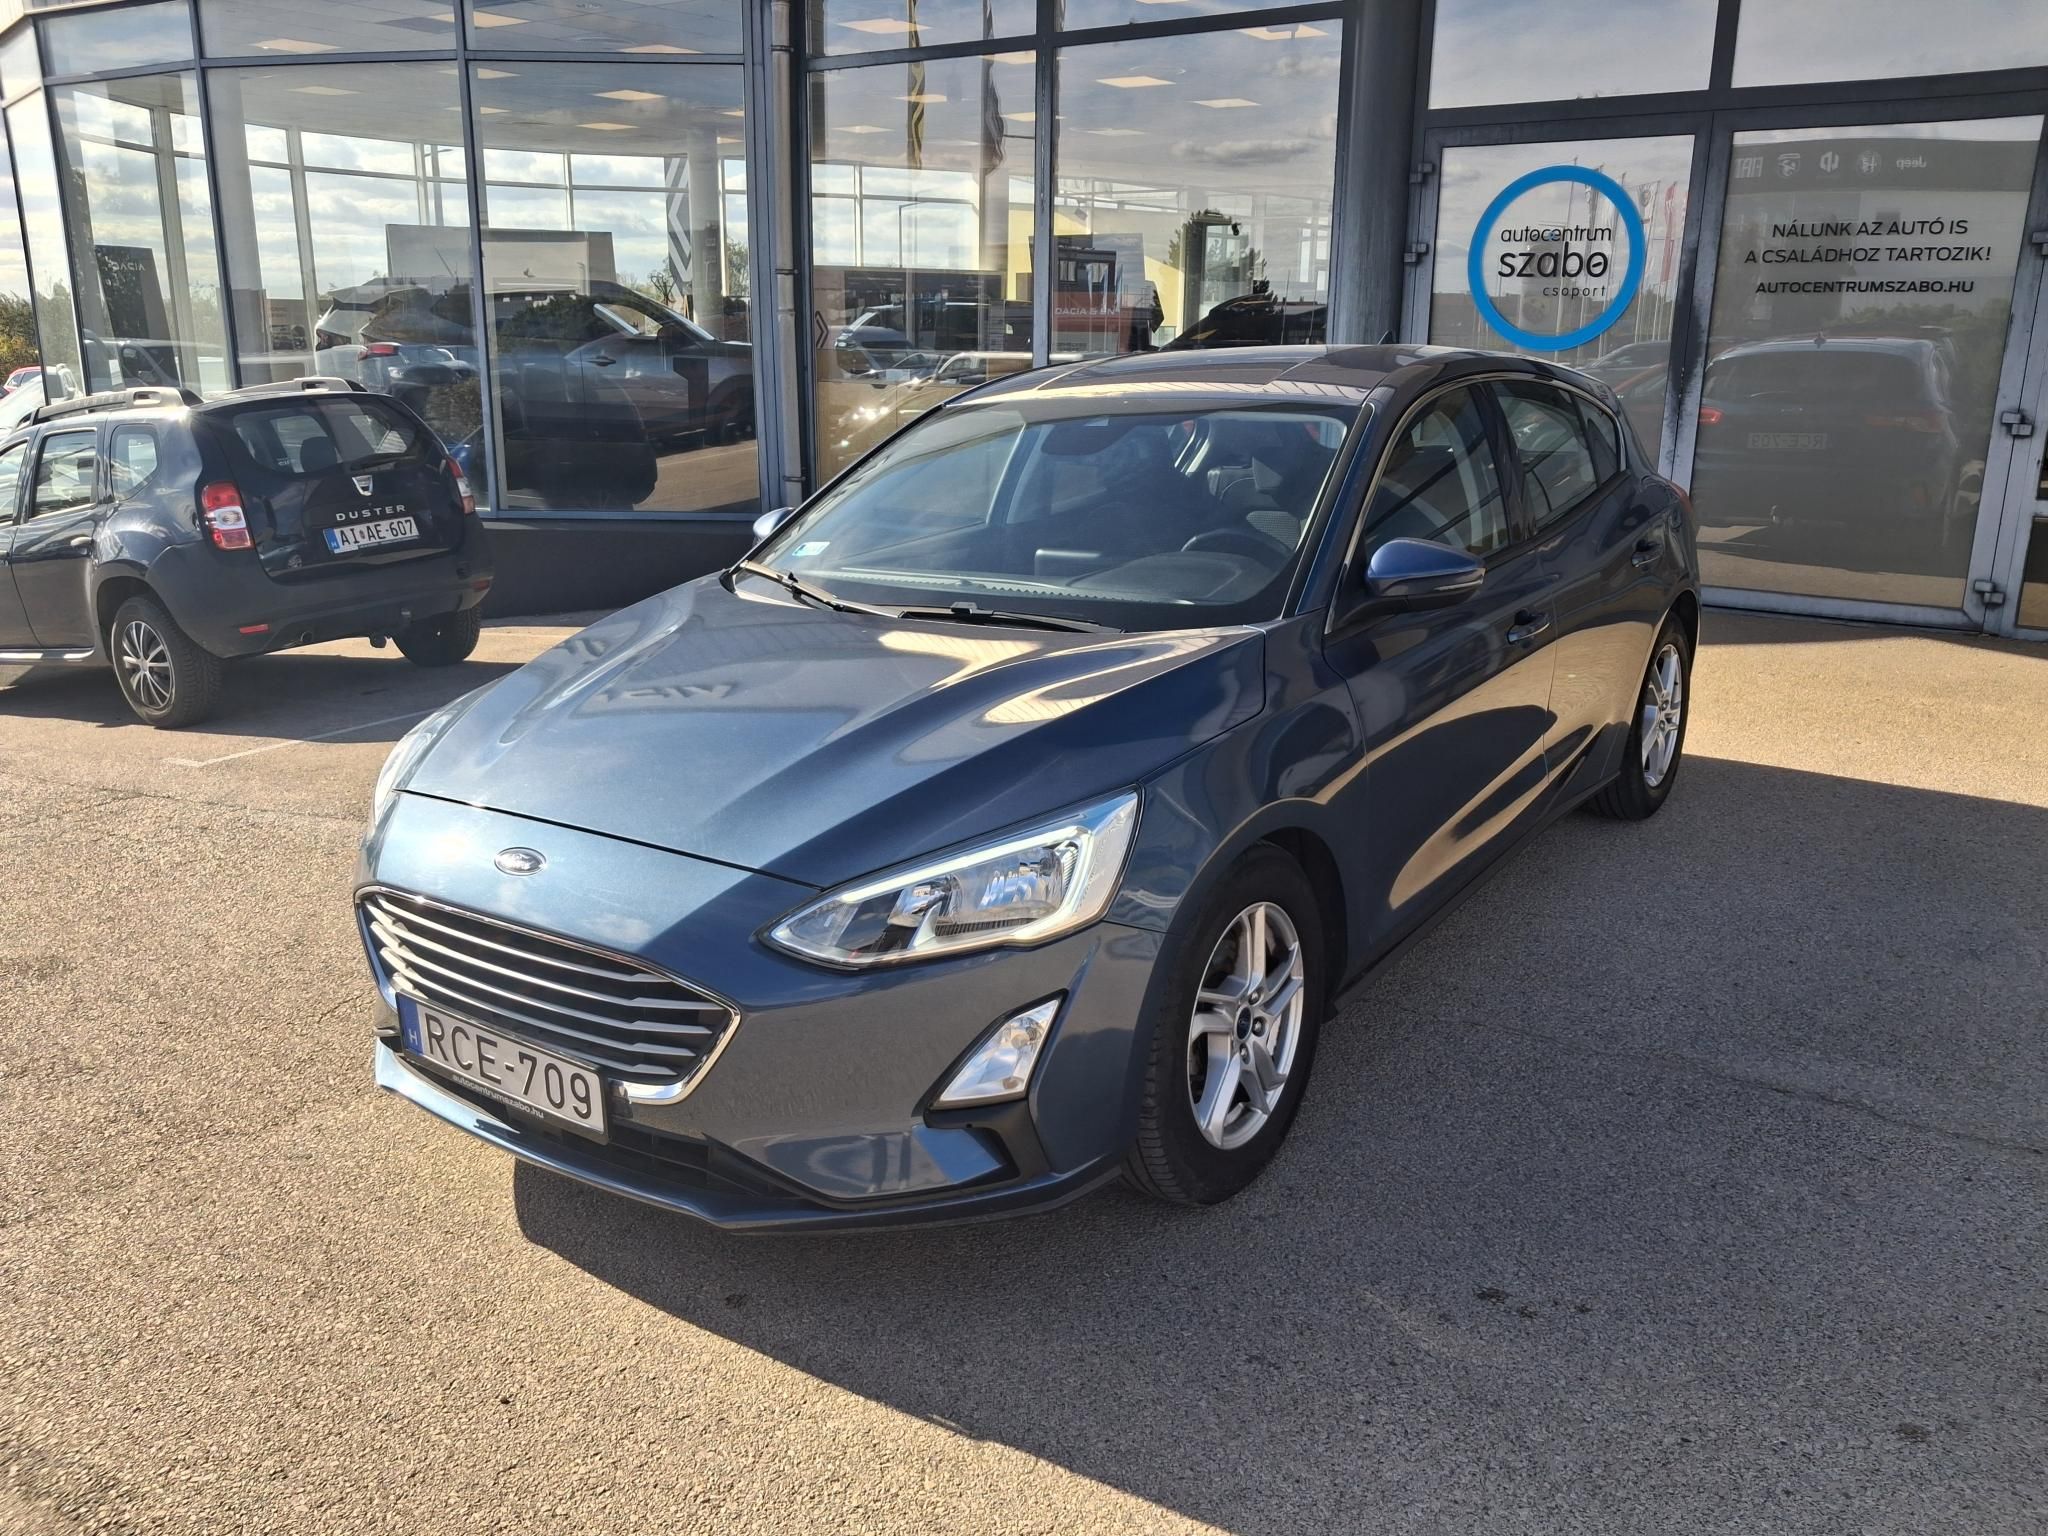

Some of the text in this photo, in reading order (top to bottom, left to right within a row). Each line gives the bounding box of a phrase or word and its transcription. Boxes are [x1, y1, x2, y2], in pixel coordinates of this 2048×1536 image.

[1500, 224, 1613, 243] autocentrum
[1772, 216, 1969, 238] NÁLUNK AZ AUTÓ IS
[1744, 245, 1992, 264] A CSALÁDHOZ TARTOZIK!
[1542, 284, 1607, 300] csoport
[1755, 280, 1975, 295] AUTOCENTRUMSZABO.HU
[335, 504, 406, 521] DUSTER
[408, 1028, 419, 1046] H
[424, 1012, 592, 1120] RCE-709
[451, 1073, 545, 1120] autocentrumszabo.hu
